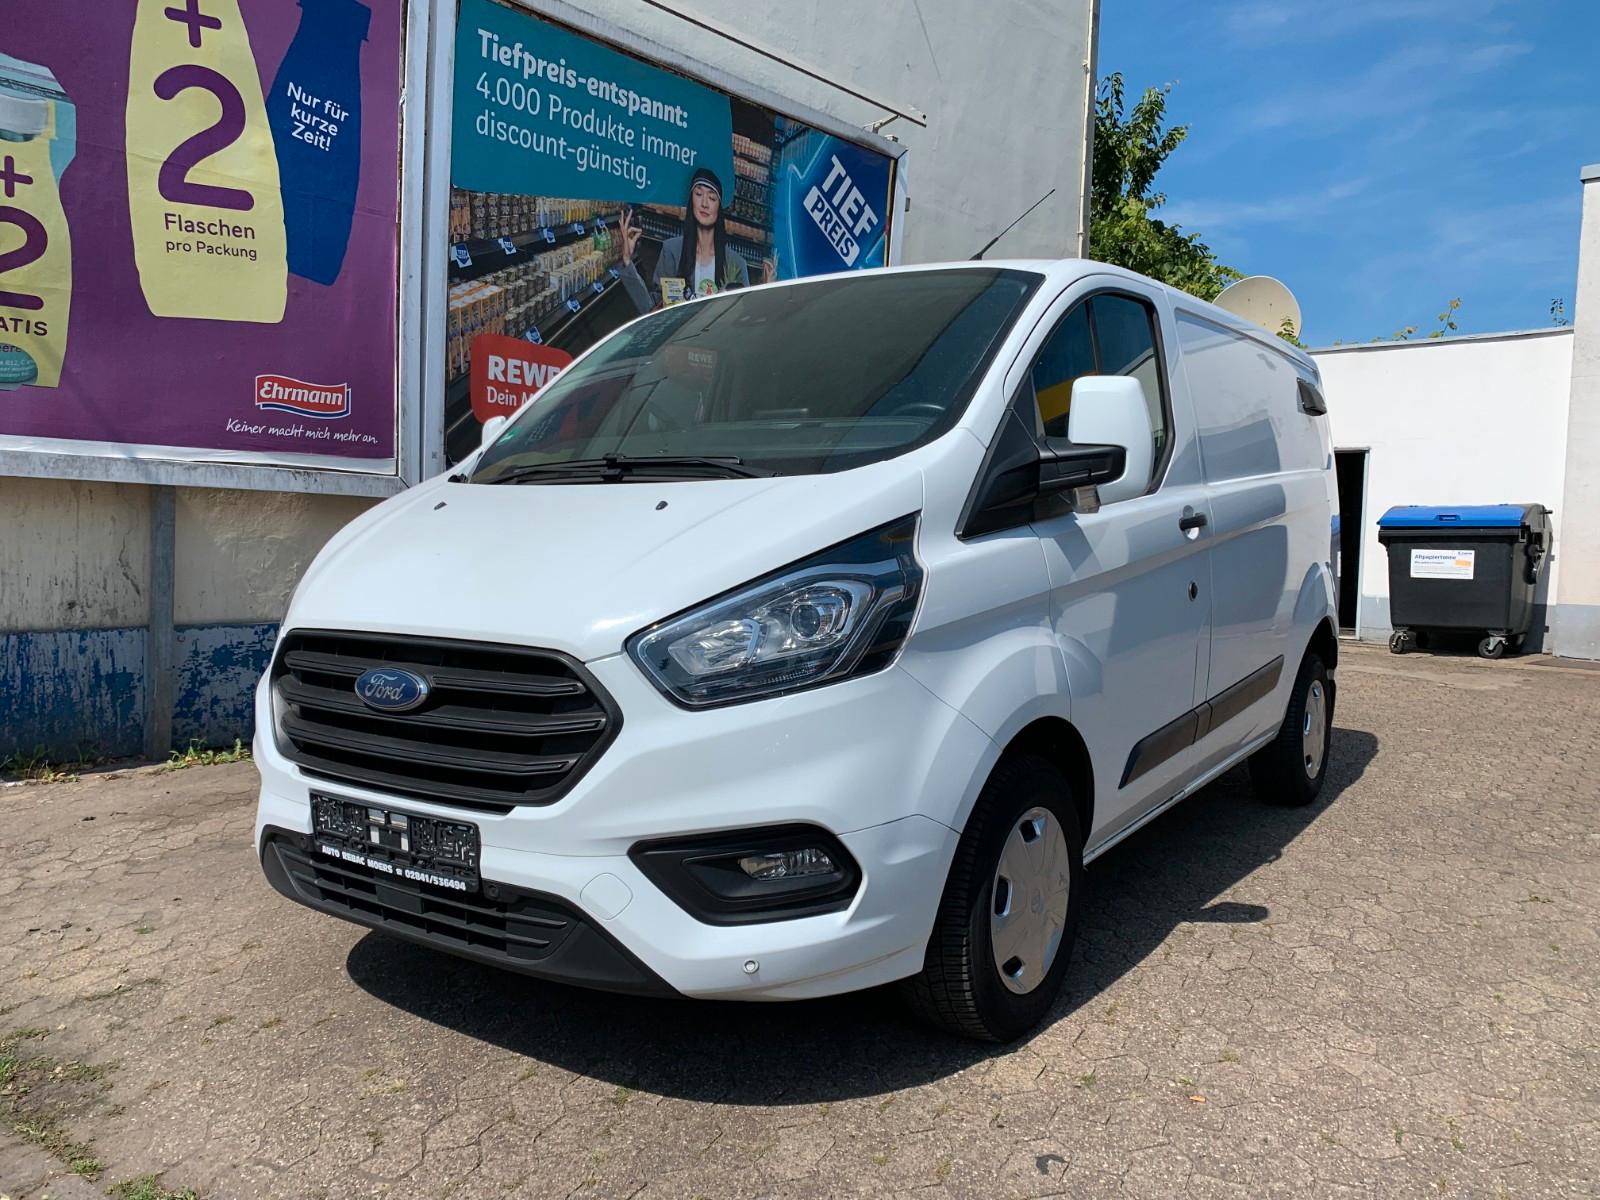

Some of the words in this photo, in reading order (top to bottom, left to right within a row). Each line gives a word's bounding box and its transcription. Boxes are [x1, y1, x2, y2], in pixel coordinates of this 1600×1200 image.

[478, 28, 688, 128] Tiefpreis-entspannt:
[287, 82, 321, 108] Nur
[324, 100, 349, 122] für
[291, 102, 338, 136] kurze
[476, 72, 541, 115] 4.000
[548, 93, 635, 147] Produkte
[641, 126, 698, 166] immer
[153, 64, 255, 211] 2
[291, 121, 331, 152] Zeit!
[476, 109, 652, 189] discount-günstig.
[822, 154, 879, 237] TIEF
[164, 213, 255, 239] Flaschen
[810, 194, 855, 258] PREIS
[166, 241, 192, 253] pro
[196, 241, 257, 261] Packung
[260, 381, 343, 406] Ehrmann
[487, 386, 517, 407] Dein
[226, 418, 266, 433] Keiner
[268, 424, 305, 437] macht
[305, 427, 331, 440] mich
[333, 430, 362, 442] mehr
[362, 435, 379, 444] an.
[364, 673, 405, 700] Ford
[322, 845, 340, 858] AUTO
[366, 858, 393, 874] MOERS
